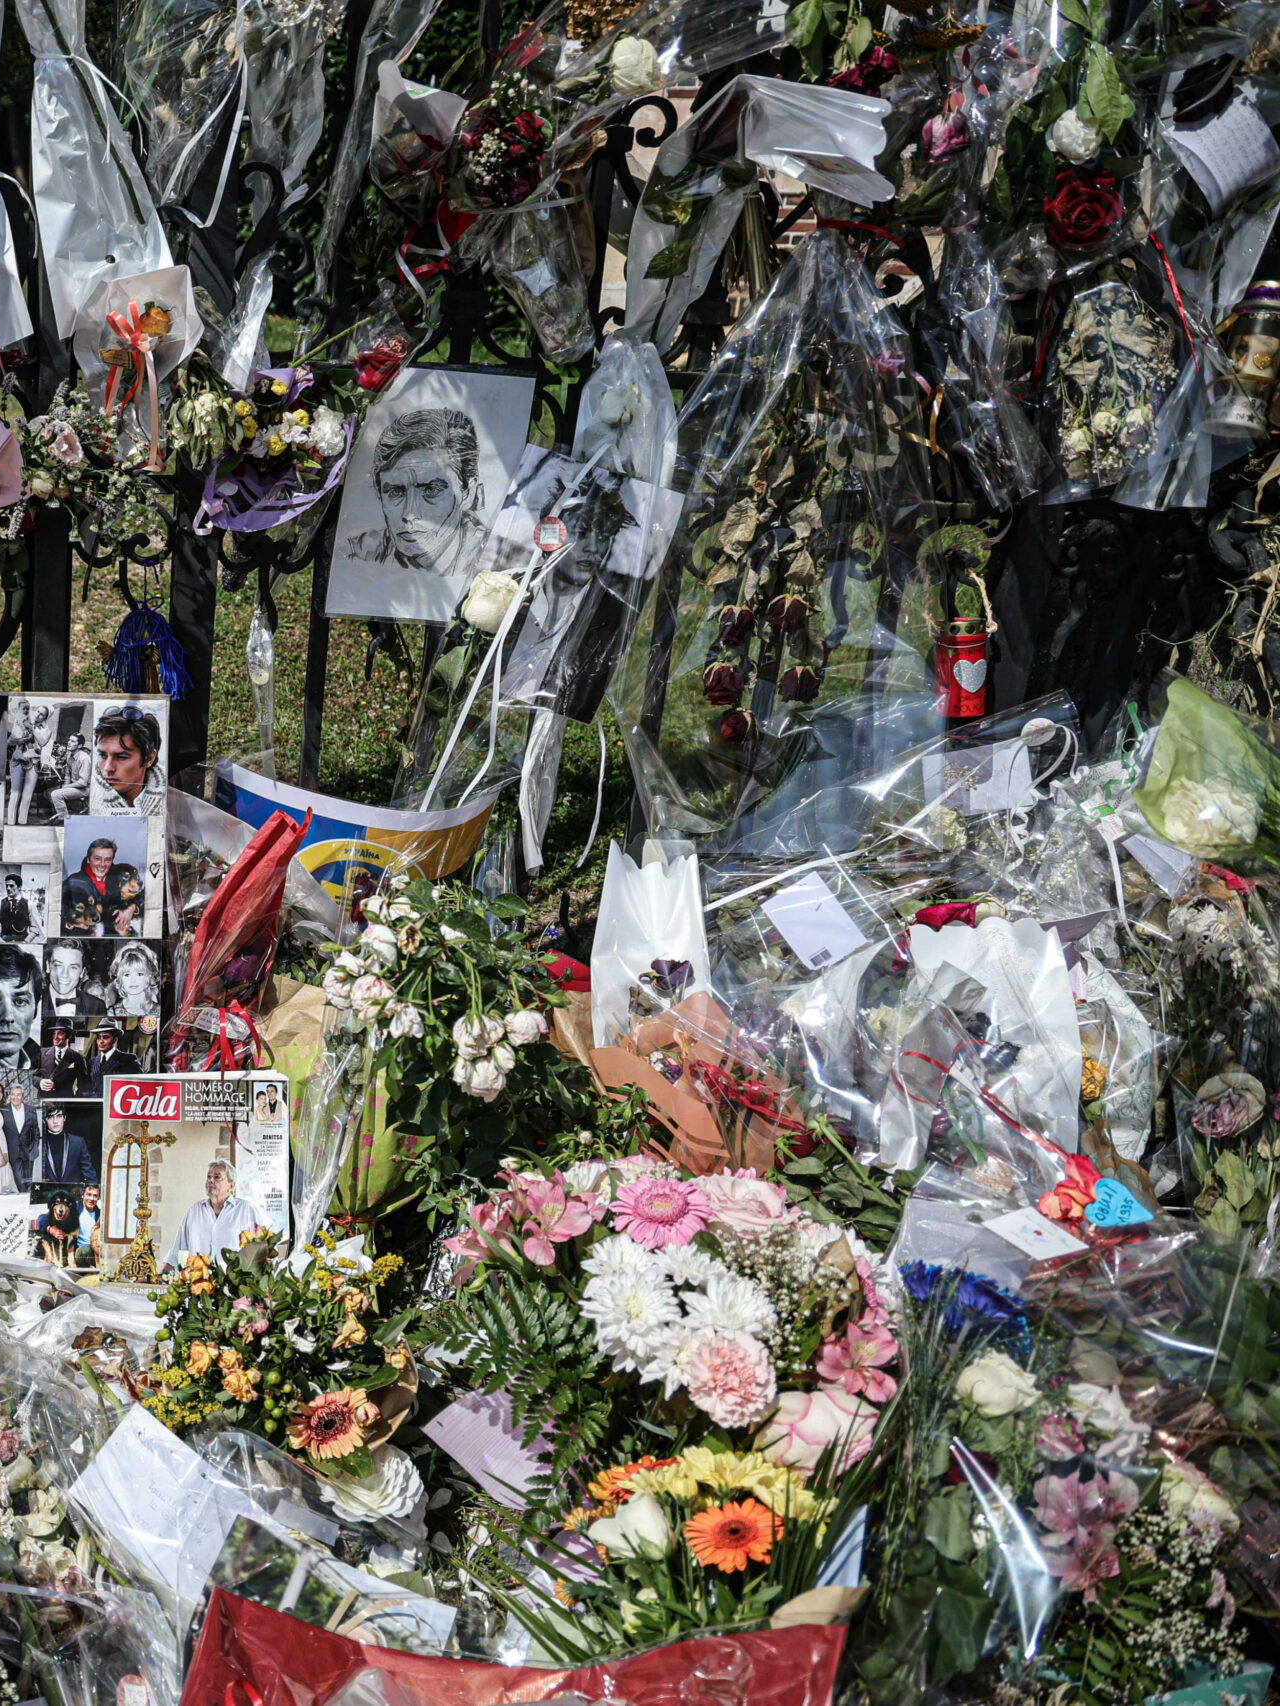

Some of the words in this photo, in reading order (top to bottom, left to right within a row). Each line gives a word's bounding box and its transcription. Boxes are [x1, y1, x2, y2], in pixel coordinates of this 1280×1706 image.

[113, 1084, 177, 1117] Gala
[185, 1081, 233, 1093] NUMÉRO
[185, 1092, 245, 1103] HOMMAGE
[1118, 1197, 1134, 1223] 1935
